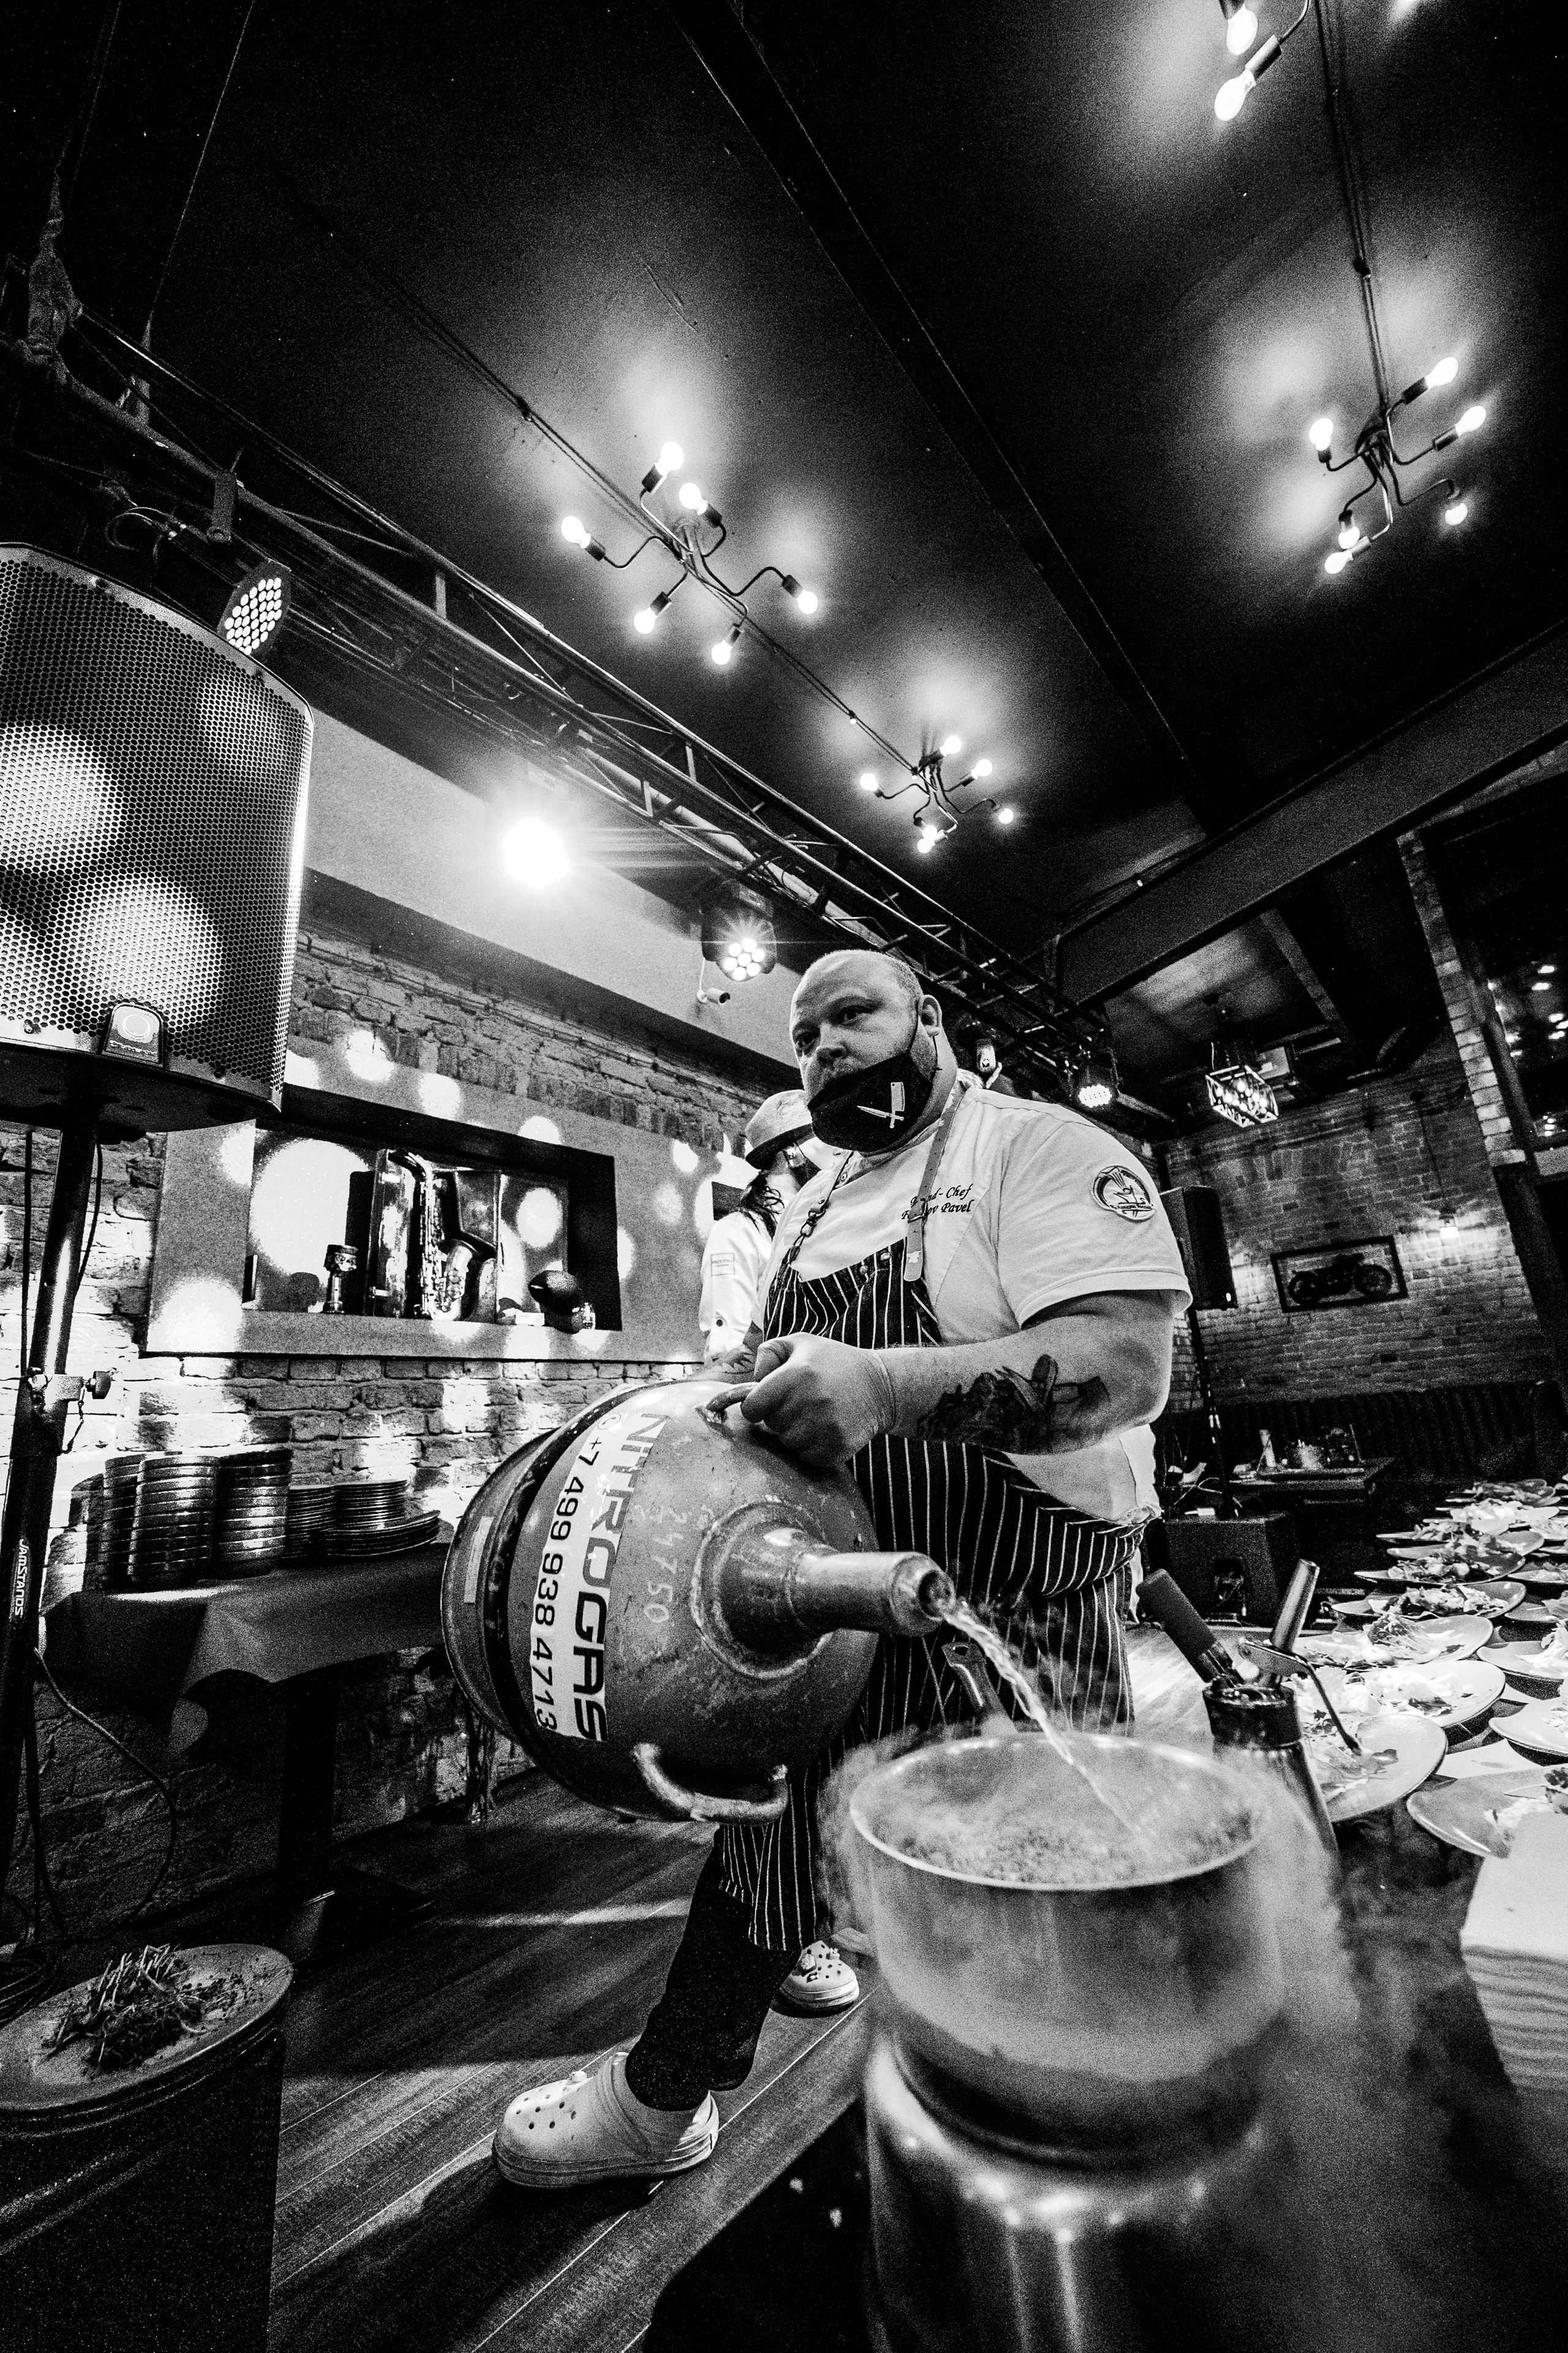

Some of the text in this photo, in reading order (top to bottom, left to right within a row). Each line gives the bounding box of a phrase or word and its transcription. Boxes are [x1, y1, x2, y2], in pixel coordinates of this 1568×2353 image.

[946, 1183, 974, 1200] Chef
[941, 1199, 974, 1213] Pavel
[532, 1437, 602, 1730] +7 499 938 4713
